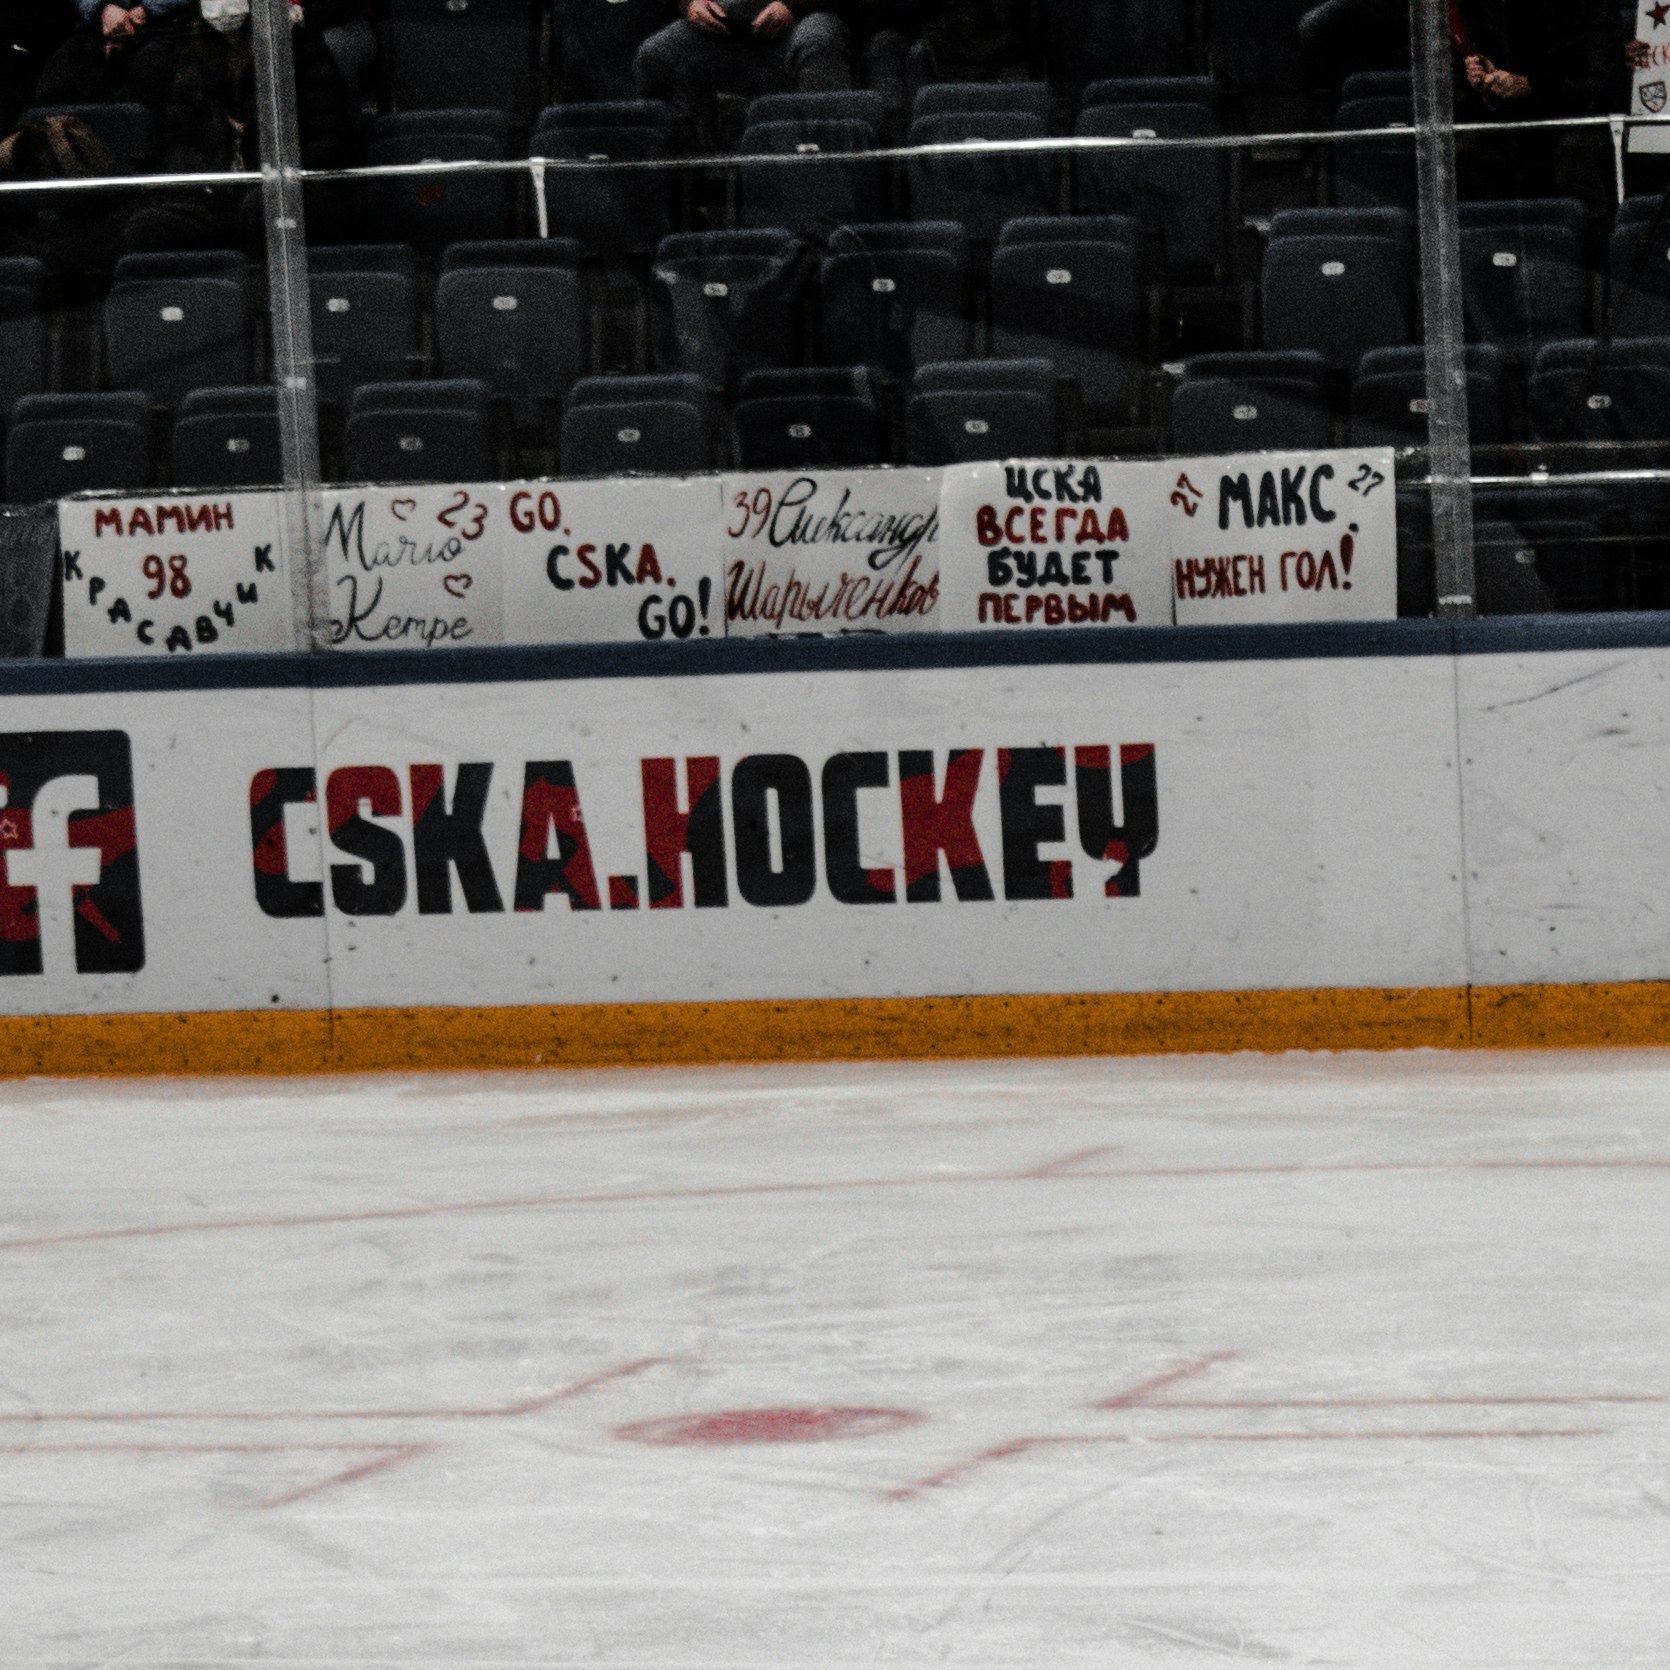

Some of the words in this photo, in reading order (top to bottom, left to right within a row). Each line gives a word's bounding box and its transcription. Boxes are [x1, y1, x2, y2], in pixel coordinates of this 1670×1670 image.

[1005, 465, 1102, 503] ЦСКА
[95, 502, 234, 537] МАМИН
[326, 500, 462, 572] Mario
[437, 490, 489, 540] 23
[727, 488, 772, 538] 39
[976, 505, 1130, 546] ВСЕГДА
[142, 553, 192, 599] 98
[987, 548, 1120, 588] БУДЕТ
[1175, 554, 1266, 600] НУЖЕН
[1280, 533, 1354, 592] ГОЛ!
[330, 574, 473, 647] Kempe
[638, 576, 711, 640] GO!
[978, 593, 1137, 626] ПЕРВЫМ
[249, 743, 1160, 918] CSKA.HOCKEY
